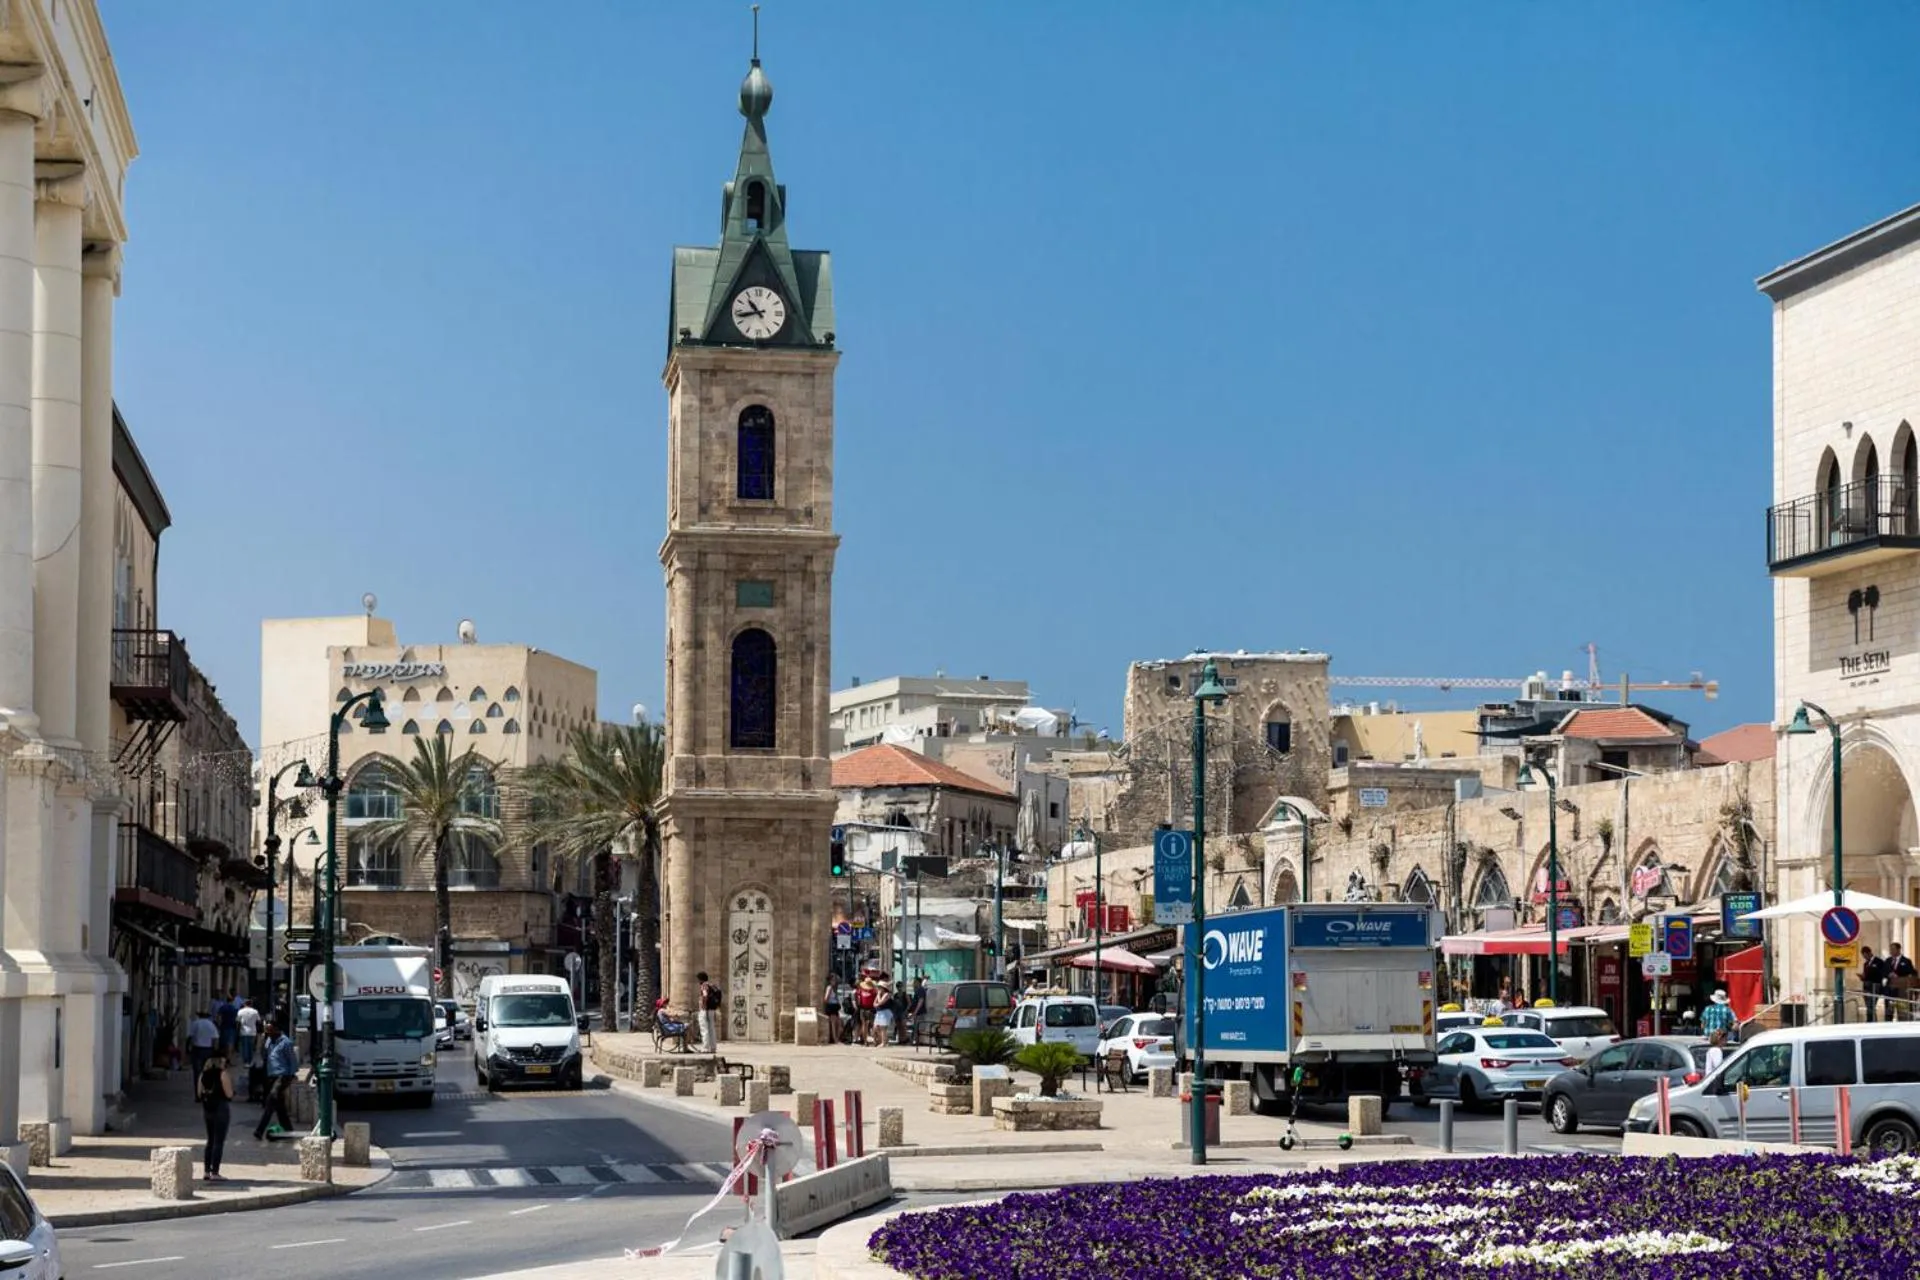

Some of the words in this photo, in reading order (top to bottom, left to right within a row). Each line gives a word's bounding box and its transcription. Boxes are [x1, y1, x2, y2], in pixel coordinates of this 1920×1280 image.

[1839, 656, 1861, 675] THE
[1863, 651, 1890, 670] SETAI
[1356, 921, 1392, 932] WAVE
[1228, 930, 1264, 963] WAVE
[358, 986, 406, 994] ISUZU
